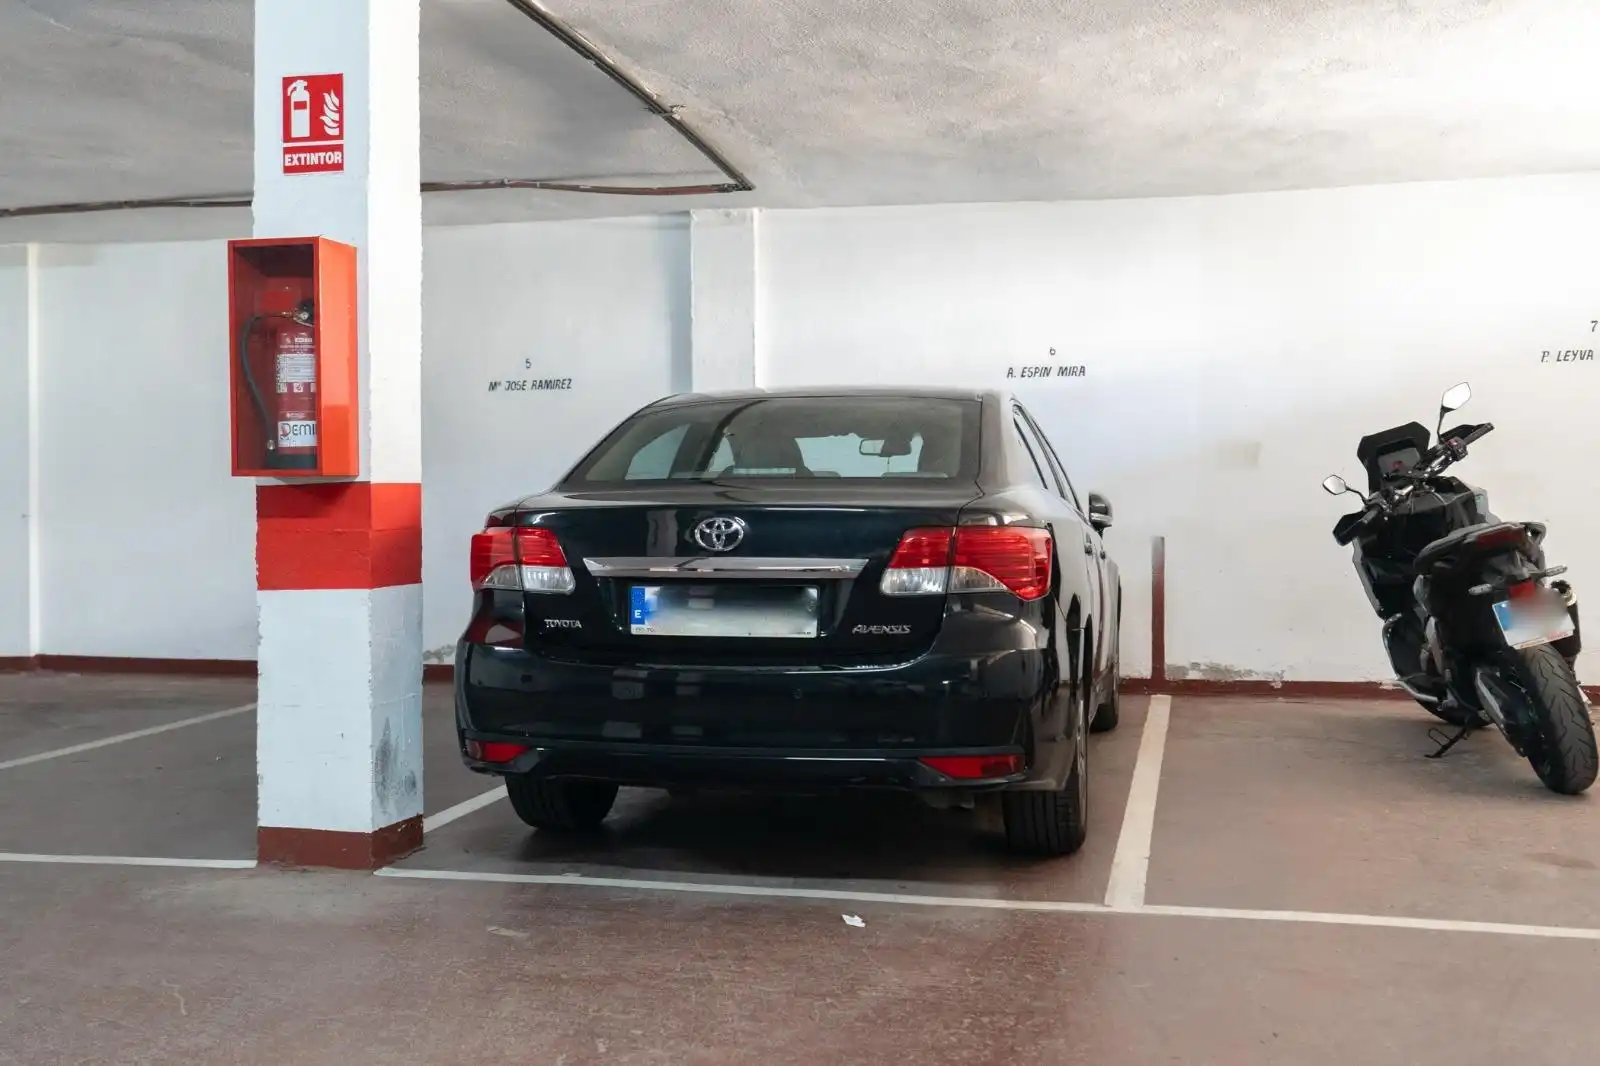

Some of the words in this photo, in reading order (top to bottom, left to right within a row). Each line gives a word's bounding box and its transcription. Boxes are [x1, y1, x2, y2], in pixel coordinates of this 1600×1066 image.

[284, 151, 343, 167] EXTINTOR
[1591, 320, 1599, 332] 7
[1049, 346, 1056, 356] 6
[1556, 349, 1594, 362] LEYVA
[525, 358, 532, 369] 5
[1020, 366, 1052, 378] ESPIN
[1057, 365, 1086, 377] MIRA
[504, 380, 527, 391] JOSE
[530, 378, 572, 390] RAMIREZ
[634, 609, 642, 619] E
[543, 619, 583, 629] TOYOTA
[851, 624, 912, 634] AVENSIS
